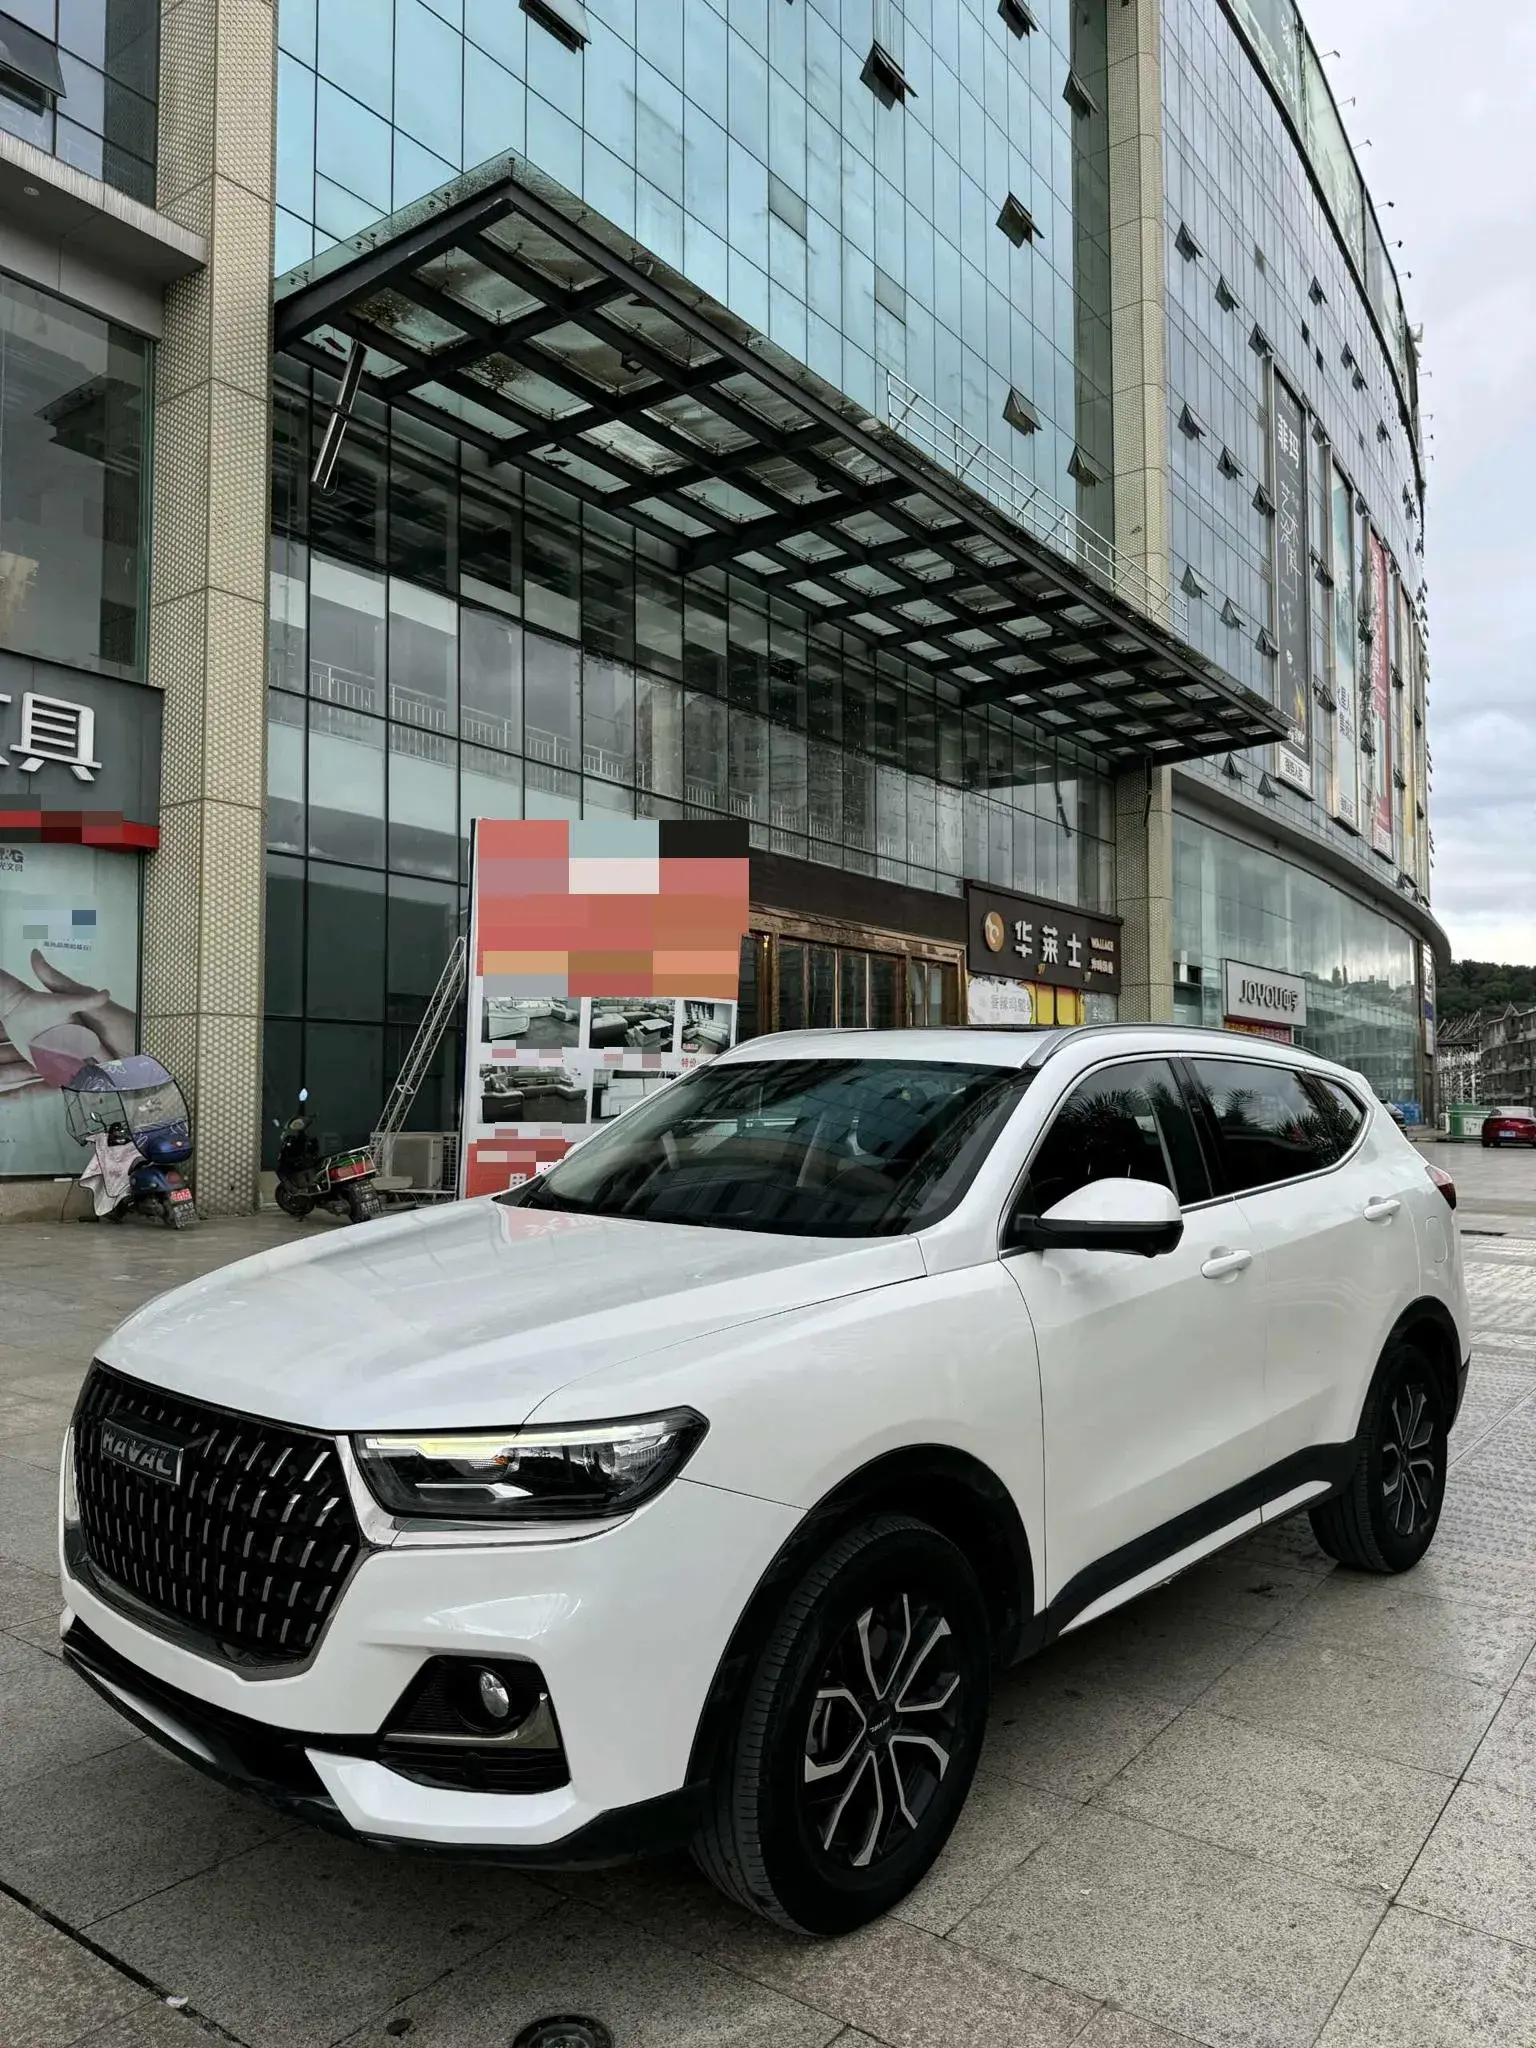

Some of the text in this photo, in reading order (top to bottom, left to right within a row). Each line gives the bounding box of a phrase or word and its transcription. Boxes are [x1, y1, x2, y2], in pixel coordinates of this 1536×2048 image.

[0, 691, 103, 782] 具
[1015, 920, 1082, 968] 华莱士
[102, 1429, 173, 1476] HAVAL
